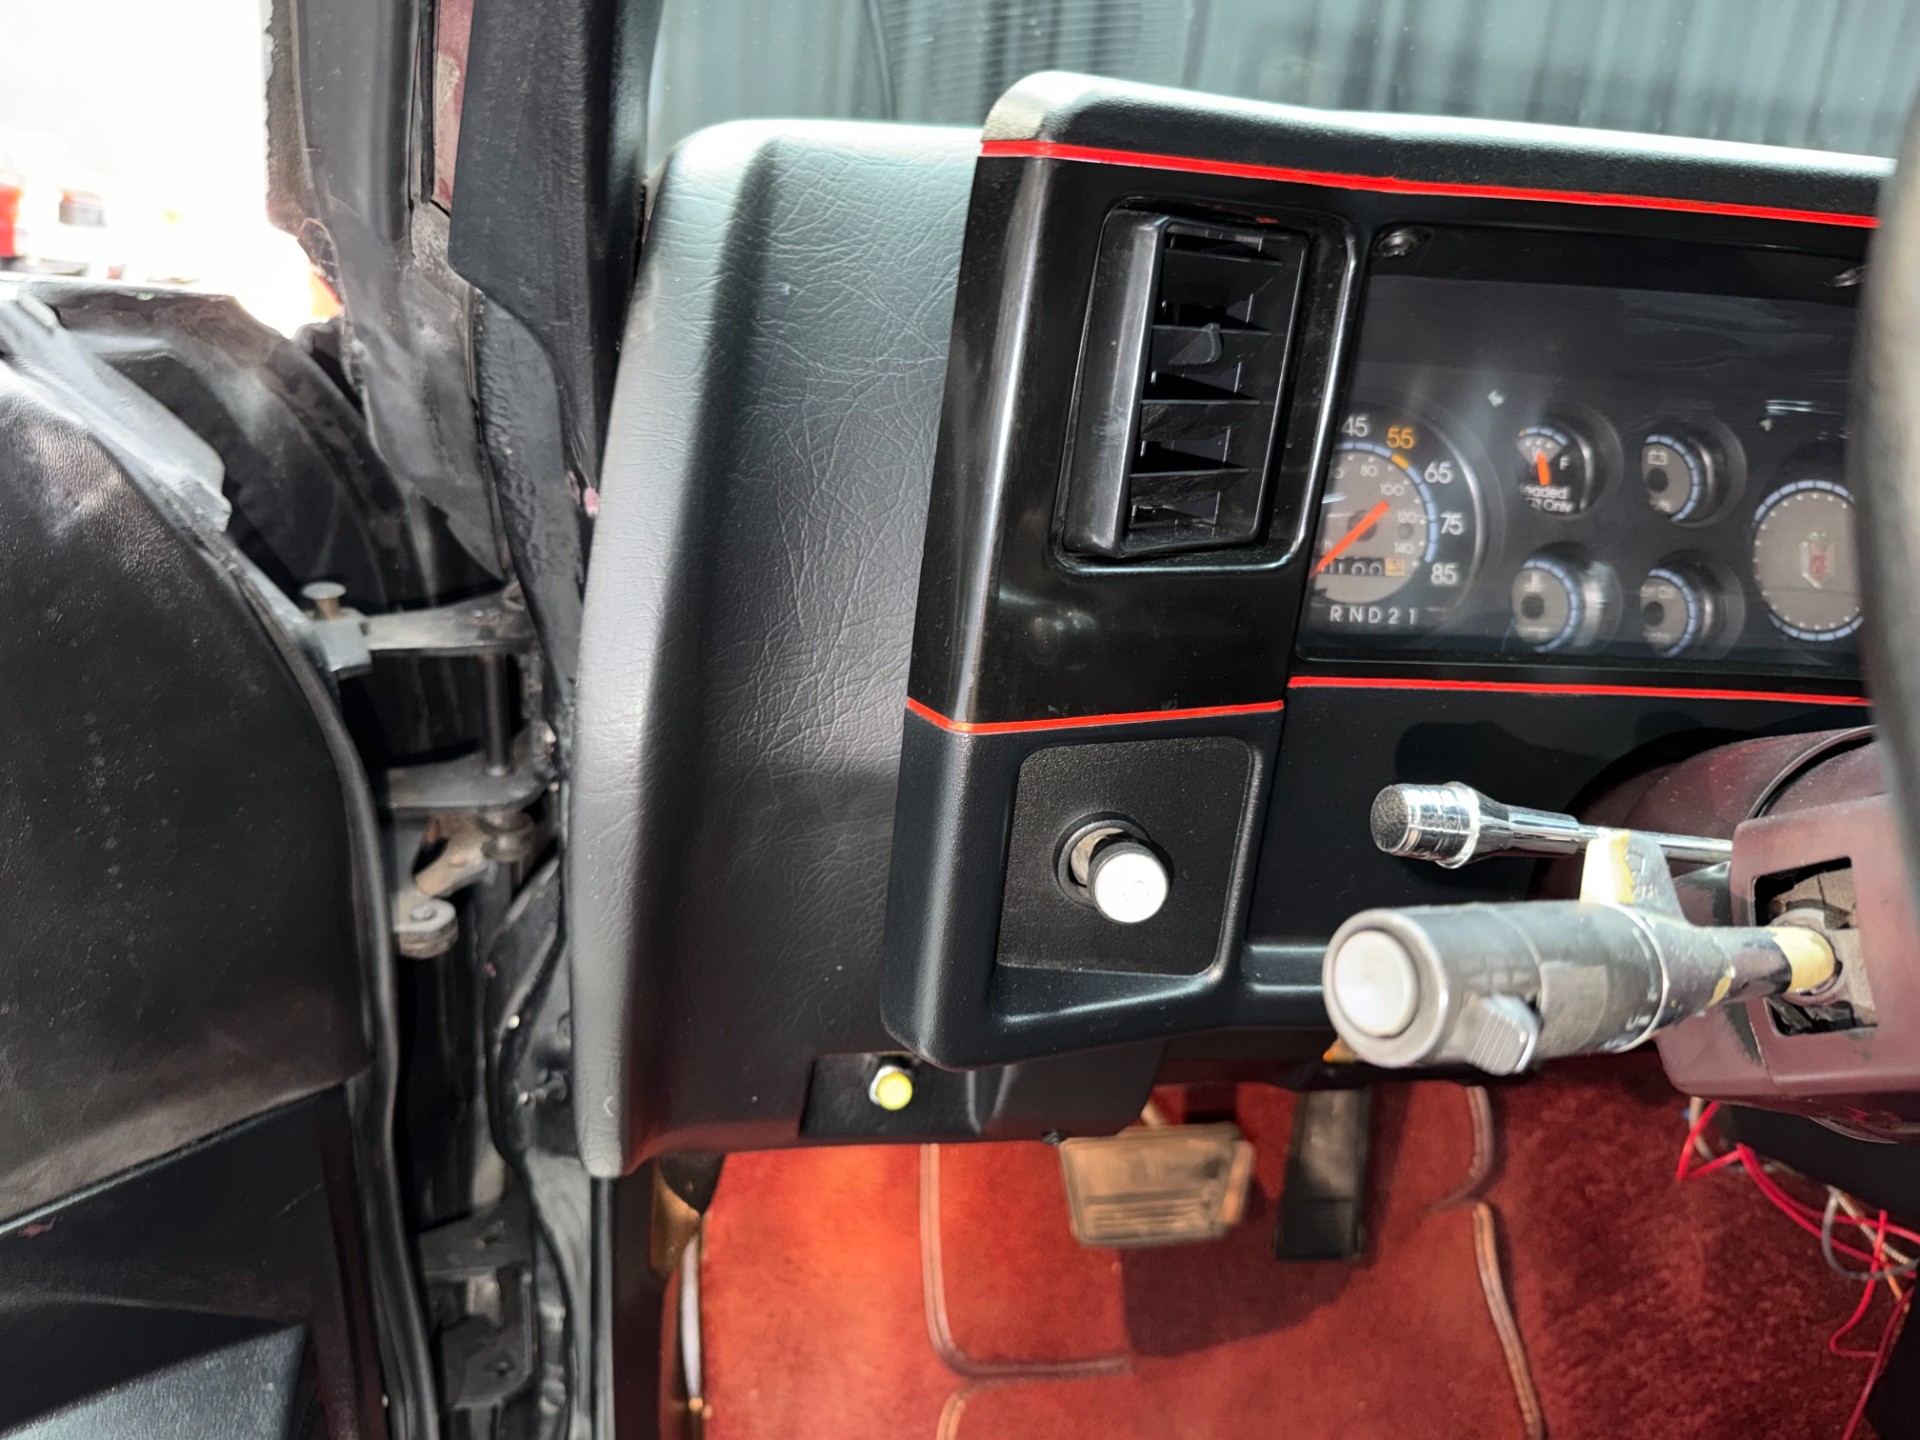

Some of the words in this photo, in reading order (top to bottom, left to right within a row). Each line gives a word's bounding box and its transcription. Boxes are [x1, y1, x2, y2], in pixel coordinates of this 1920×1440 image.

[1341, 414, 1370, 437] 45
[1386, 427, 1415, 449] 55
[1360, 465, 1378, 477] 80
[1424, 461, 1452, 483] 65
[1560, 455, 1570, 471] F
[1380, 484, 1403, 496] 100
[1397, 512, 1417, 523] 120
[1441, 513, 1464, 535] 75
[1394, 542, 1414, 554] 140
[1431, 563, 1458, 585] 85
[1330, 605, 1344, 622] R
[1349, 606, 1363, 622] N
[1368, 606, 1381, 623] D
[1388, 606, 1400, 624] 2
